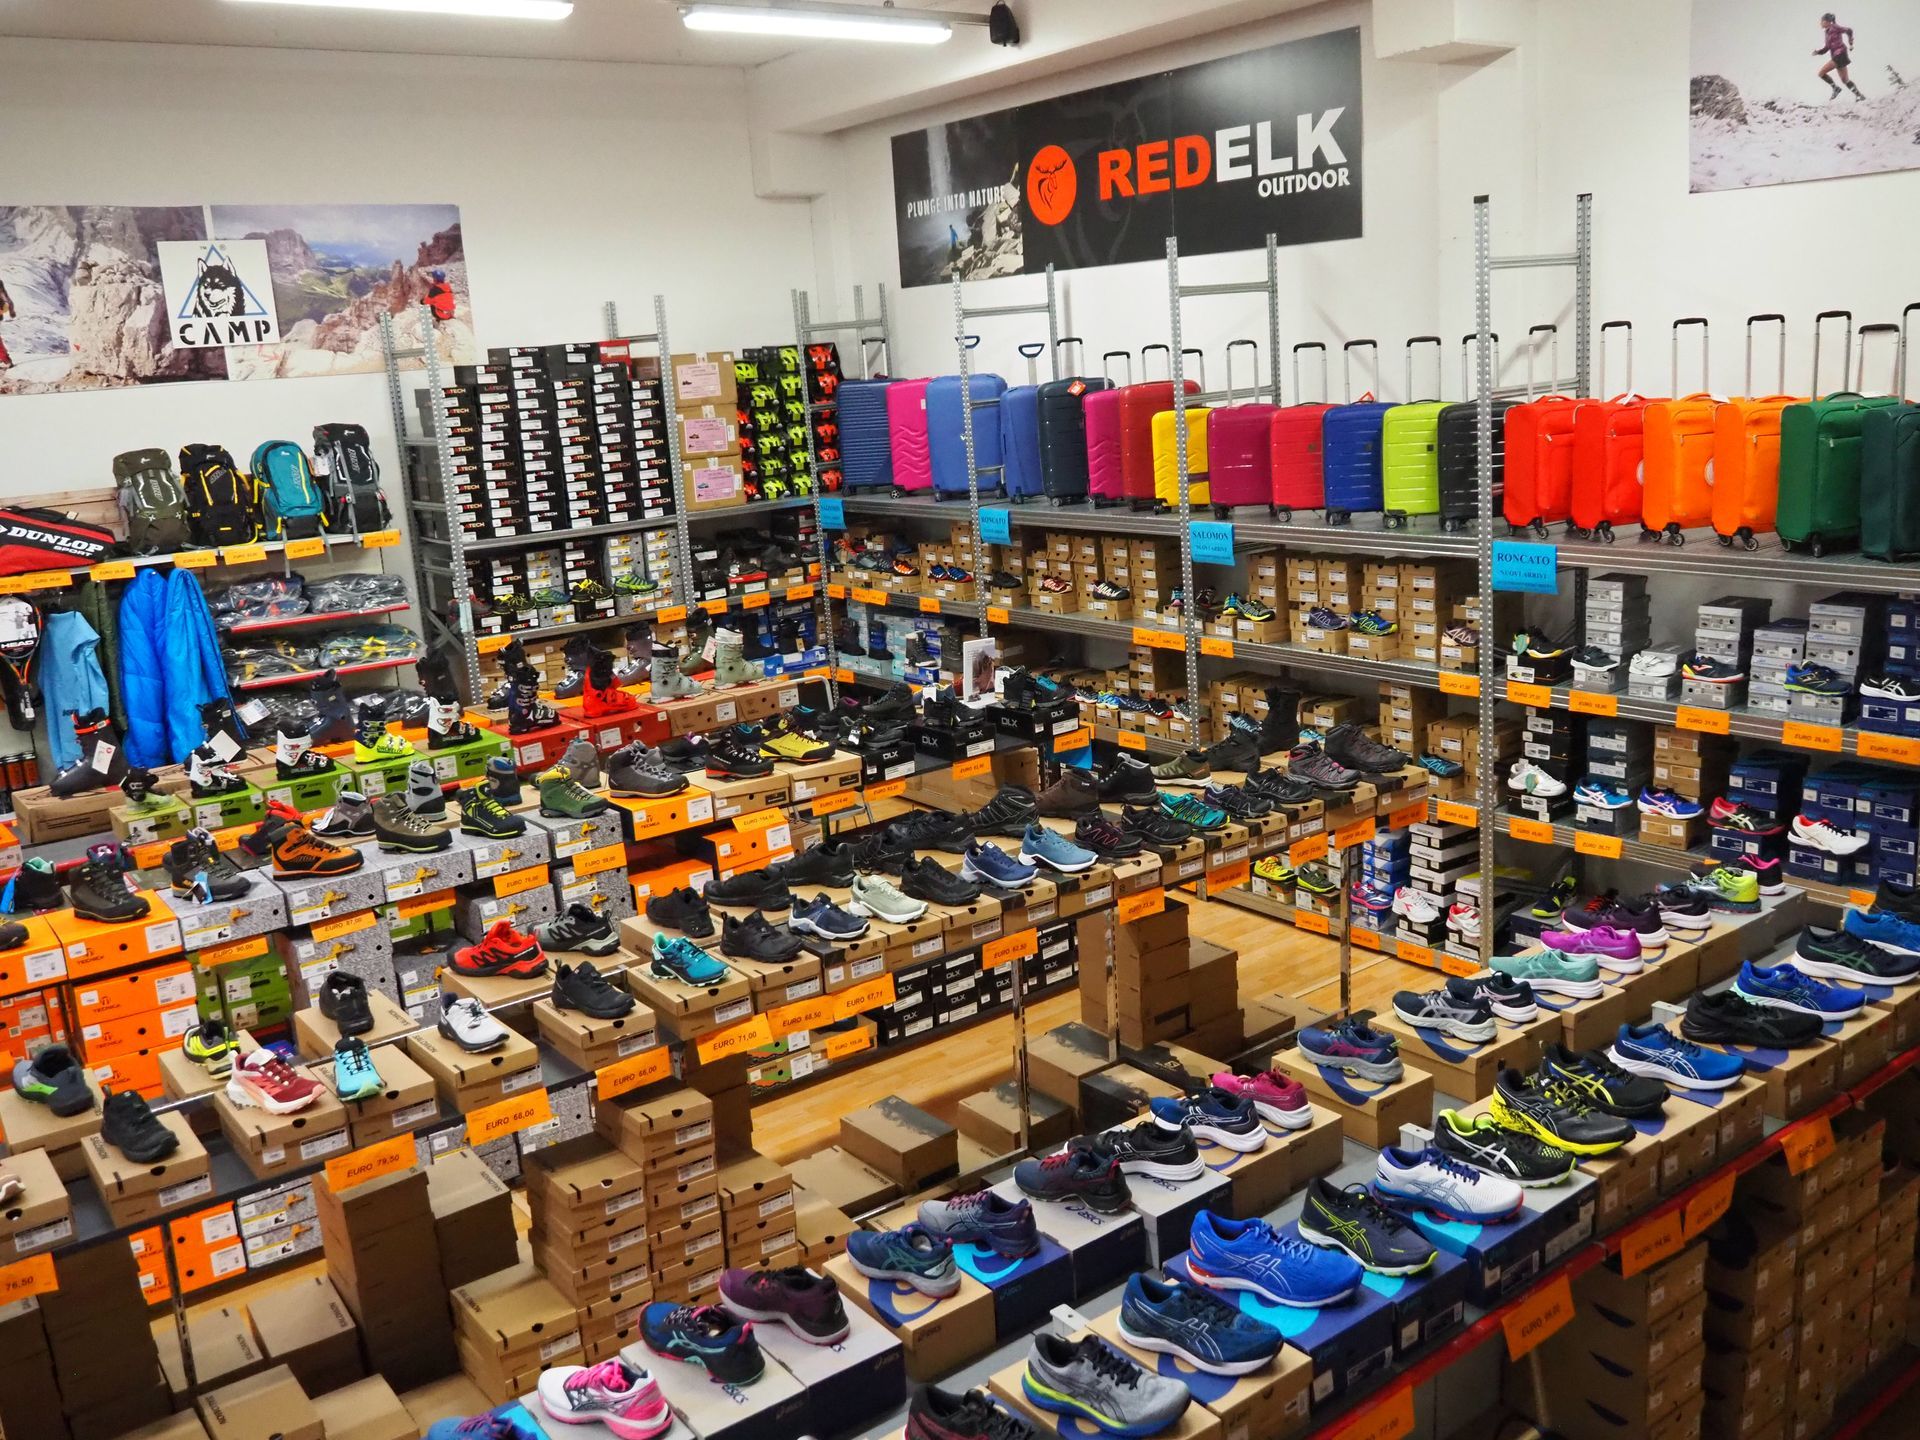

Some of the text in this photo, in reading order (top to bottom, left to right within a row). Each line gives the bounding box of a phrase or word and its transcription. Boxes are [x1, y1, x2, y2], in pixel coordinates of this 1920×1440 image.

[1098, 106, 1348, 201] REDELK
[1258, 167, 1350, 198] OUTDOOR
[907, 185, 1005, 218] PLUNGE INTO NATURE
[179, 319, 272, 345] CAMP
[7, 526, 104, 553] DUNLOP
[1192, 531, 1229, 540] SALOMON
[53, 545, 93, 557] SPORT
[1497, 552, 1550, 566] RONCATO
[0, 640, 35, 649] HEAD
[1051, 710, 1065, 718] DLX
[1001, 717, 1018, 727] DLX
[969, 730, 983, 738] DLX
[1794, 733, 1812, 741] EURO
[922, 735, 938, 747] DLX
[1870, 745, 1889, 753] EURO
[883, 751, 898, 760] DLX
[743, 818, 758, 826] EURO
[584, 859, 601, 868] EURO
[506, 879, 523, 888] EURO
[324, 922, 344, 932] EURO
[1040, 936, 1053, 945] DLX
[213, 948, 234, 958] EURO
[993, 949, 1010, 959] EURO
[1043, 961, 1058, 970] DLX
[946, 970, 960, 979] DLX
[996, 978, 1010, 987] DLX
[898, 984, 912, 993] DLX
[846, 996, 865, 1008] EURO
[951, 994, 965, 1004] DLX
[903, 1011, 918, 1021] DLX
[782, 1017, 802, 1027] EURO
[713, 1039, 735, 1050] EURO
[613, 1073, 635, 1086] EURO
[486, 1117, 510, 1130] EURO
[347, 1163, 373, 1178] EURO
[1521, 1317, 1543, 1338] EURO
